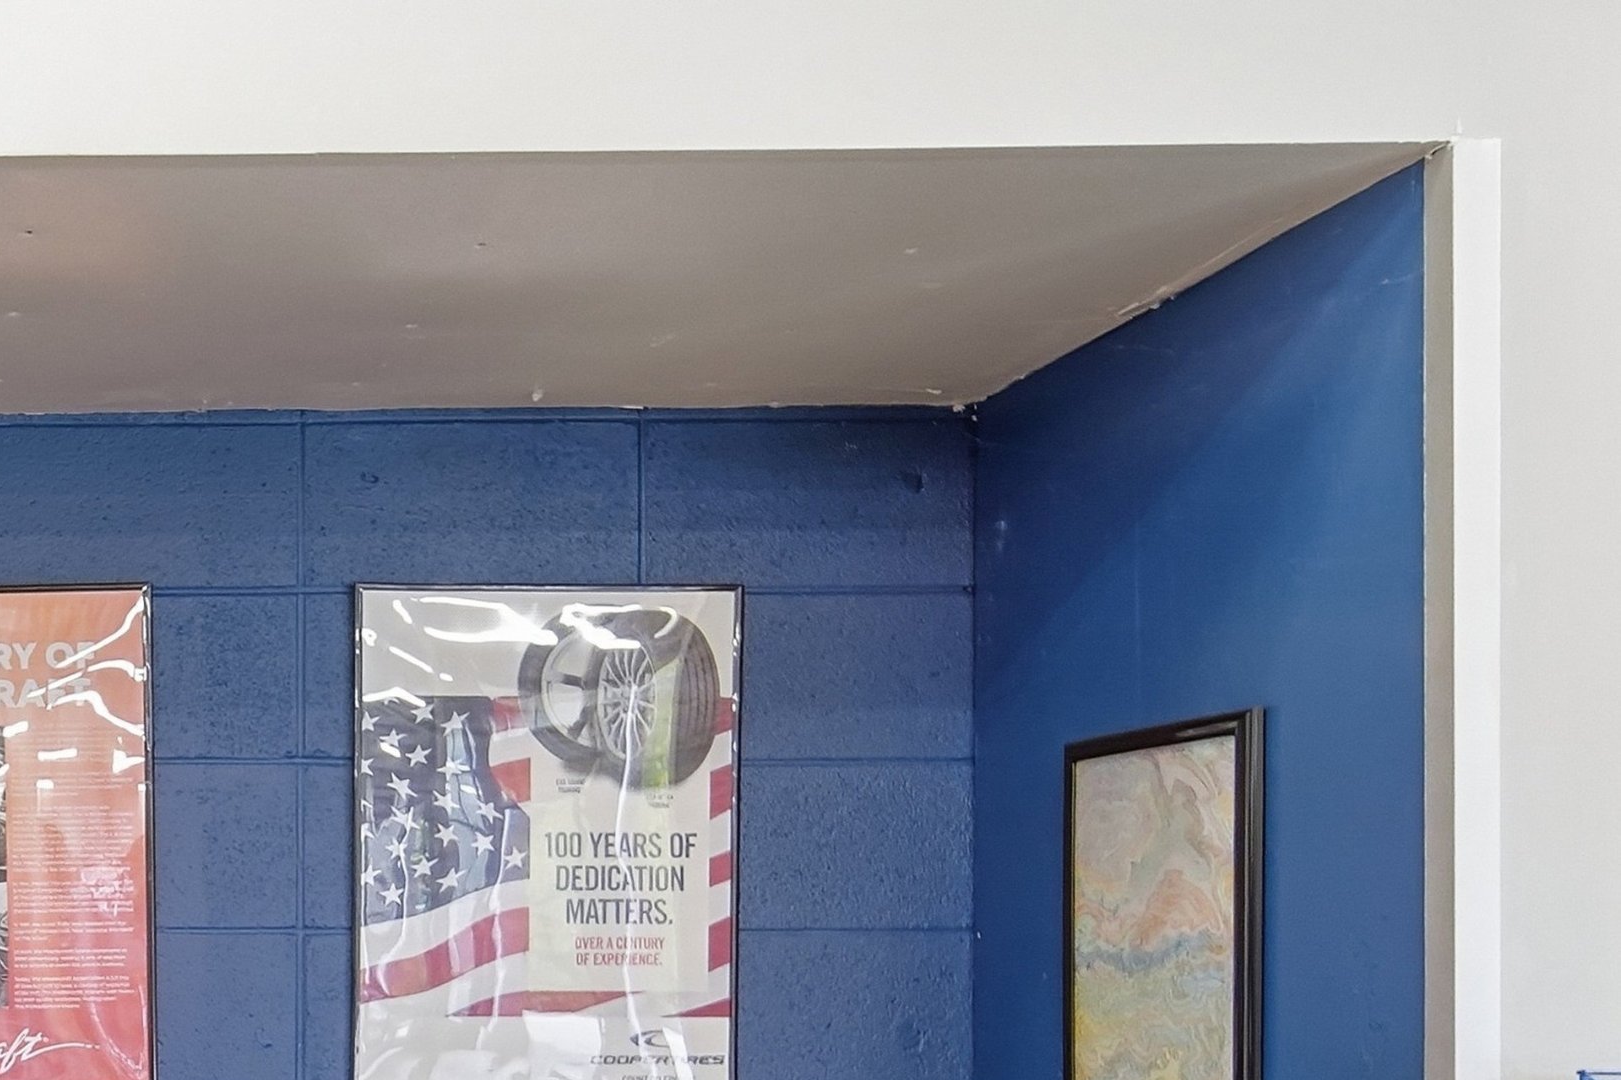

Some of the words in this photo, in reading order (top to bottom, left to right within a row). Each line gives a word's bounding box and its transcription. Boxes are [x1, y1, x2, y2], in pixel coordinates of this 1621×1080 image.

[45, 640, 96, 669] OF
[544, 832, 582, 858] 100
[589, 832, 662, 858] YEARS
[669, 832, 698, 858] OF
[555, 865, 685, 892] DEDICATION
[565, 898, 674, 925] MATTERS.
[574, 936, 603, 950] OVER
[605, 936, 614, 949] A
[576, 952, 590, 966] OF
